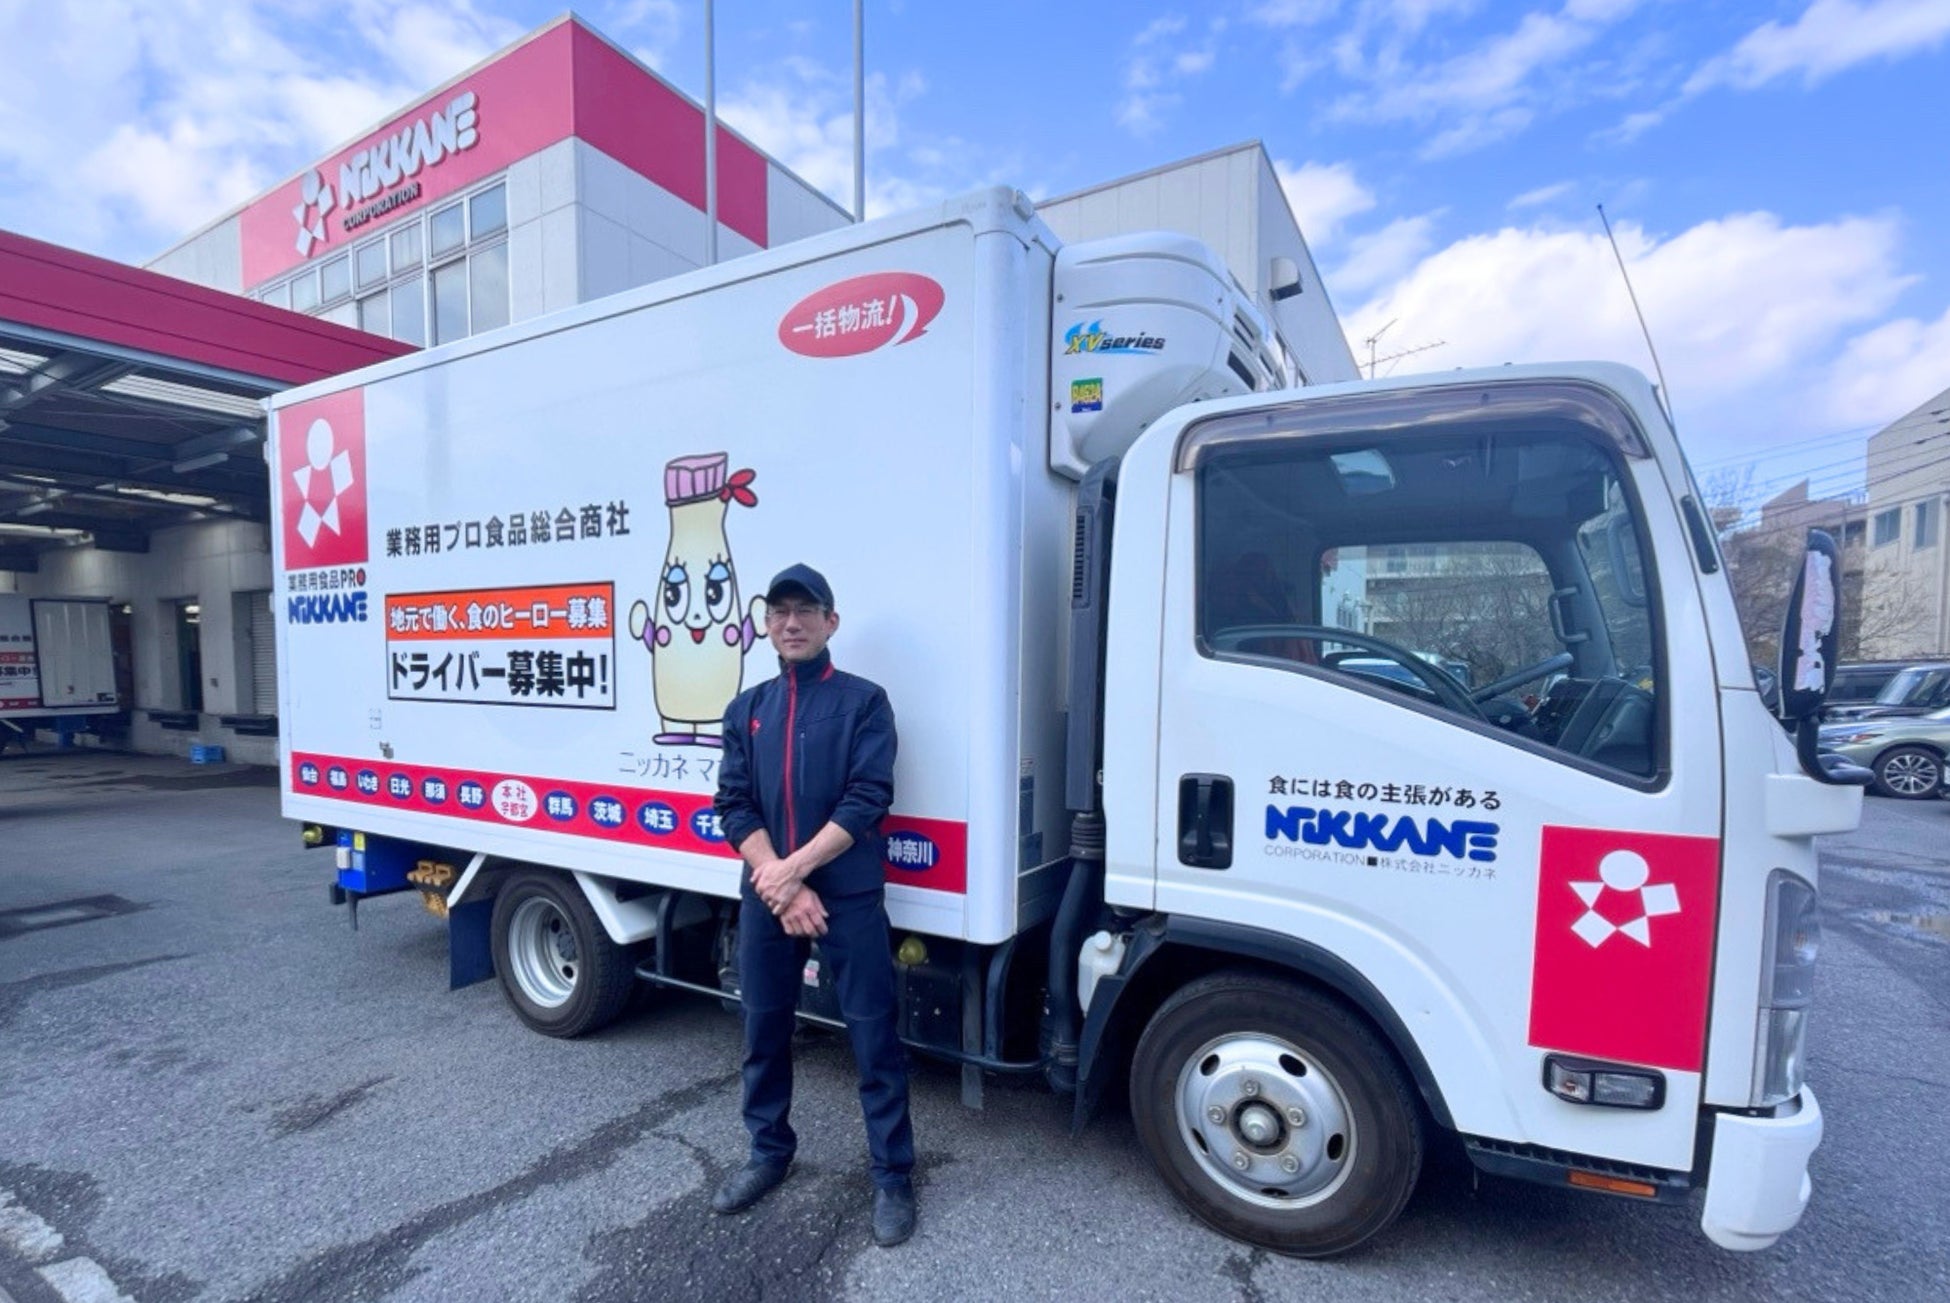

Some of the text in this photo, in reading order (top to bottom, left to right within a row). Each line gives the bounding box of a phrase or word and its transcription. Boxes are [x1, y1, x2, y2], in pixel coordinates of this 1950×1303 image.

[343, 182, 421, 231] CORPORATION
[792, 293, 898, 339] 一括物流!
[386, 500, 630, 557] 業務用プロ食品総合商社
[389, 596, 609, 633] 地元で働く、食のヒーロー募集
[391, 650, 609, 698] ドライバー募集中!
[390, 777, 410, 796] 日光
[460, 785, 483, 805] 長野
[1268, 774, 1501, 810] 食には食の主張がある
[548, 796, 573, 817] 群馬
[593, 801, 622, 824] 茨城
[643, 807, 674, 830] 埼玉
[887, 837, 933, 866] 神奈川
